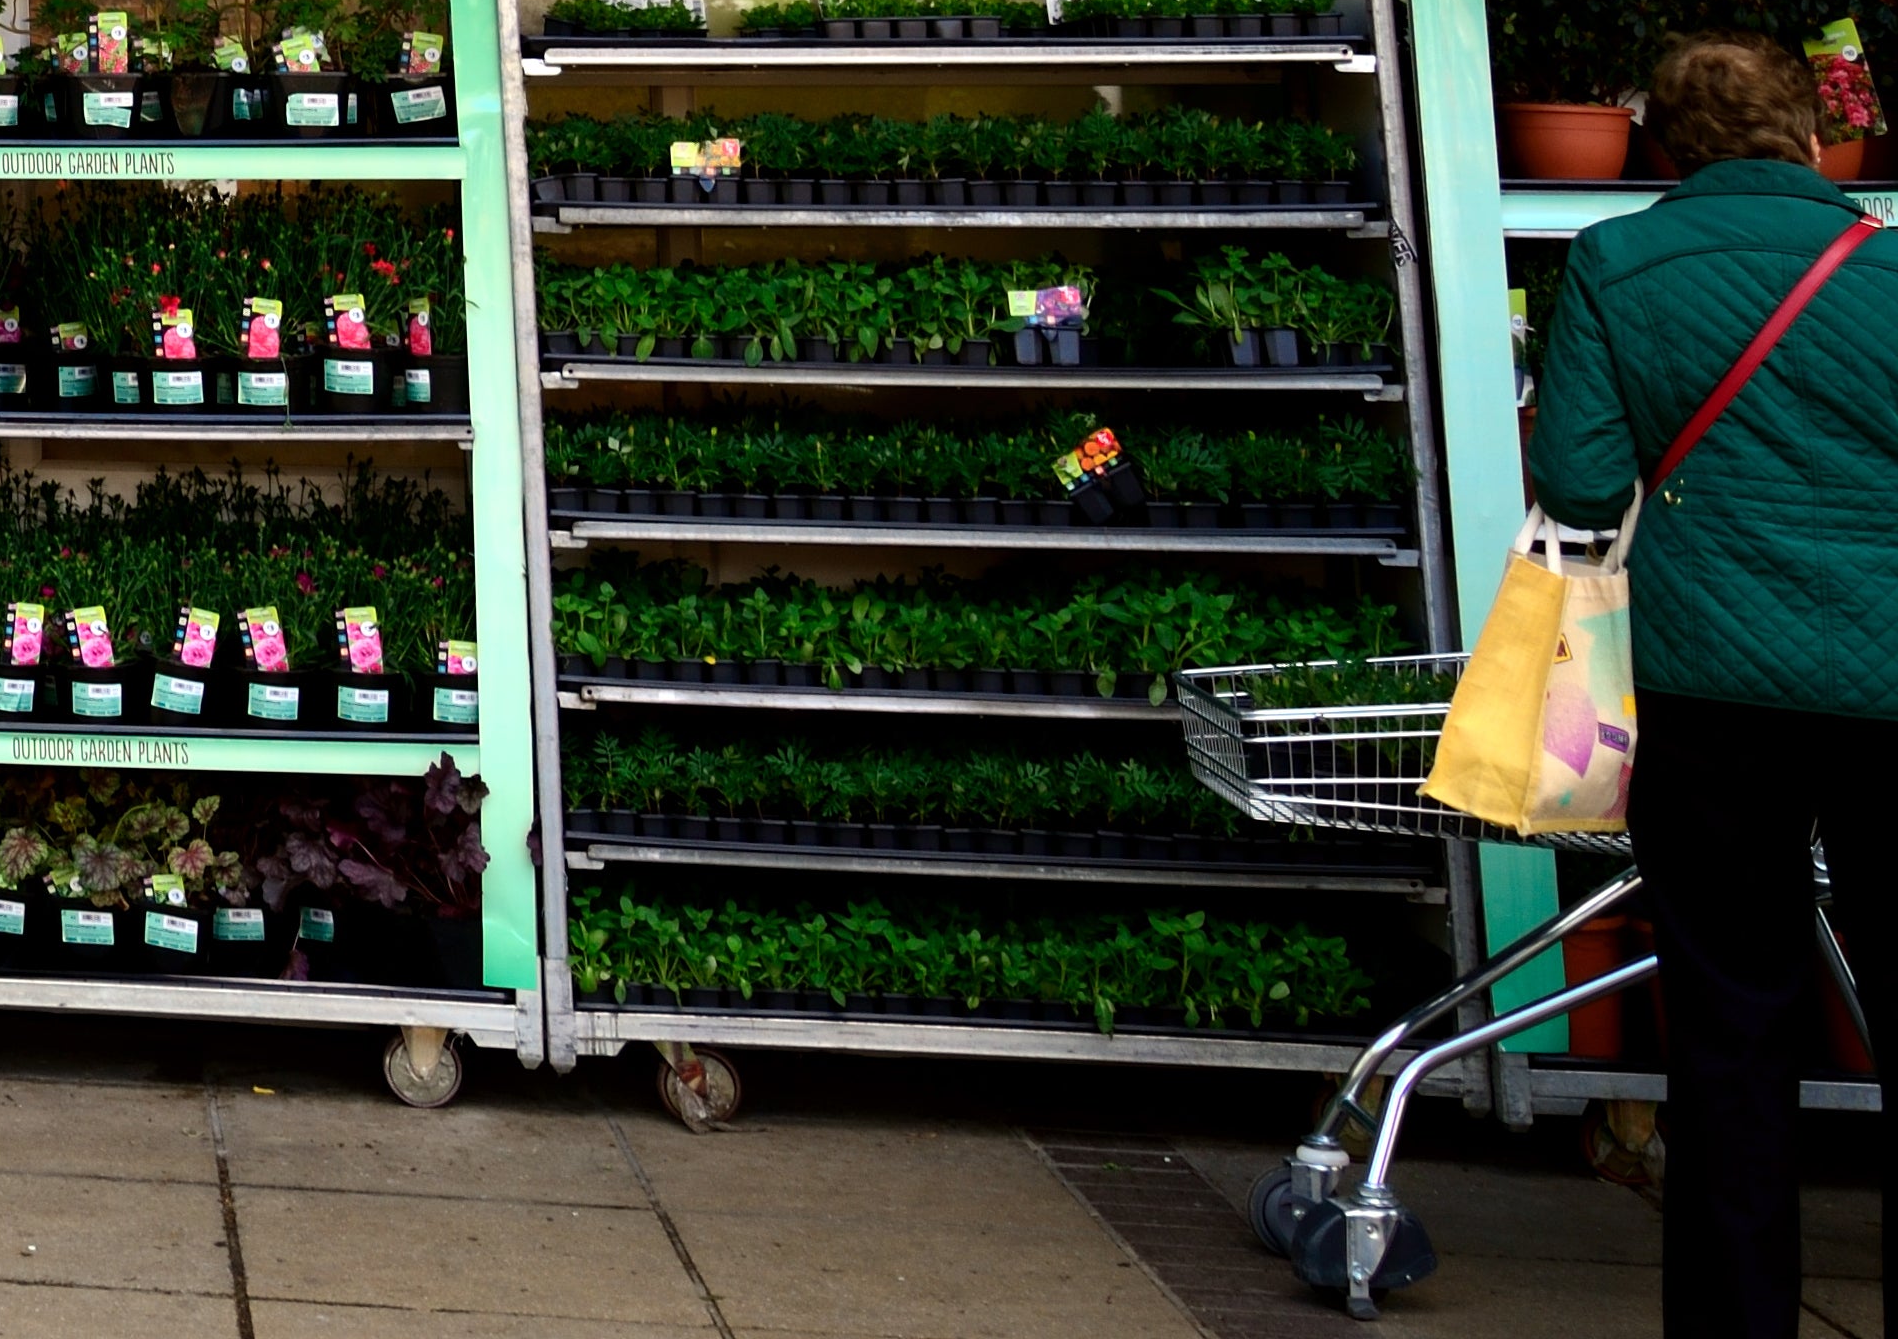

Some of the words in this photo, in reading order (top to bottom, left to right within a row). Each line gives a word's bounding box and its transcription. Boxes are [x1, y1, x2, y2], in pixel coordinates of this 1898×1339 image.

[2, 152, 62, 174] OUTDOOR
[69, 152, 119, 174] GARDEN
[125, 152, 174, 174] PLANTS
[13, 737, 74, 761] OUTDOOR
[81, 739, 131, 763] GARDEN
[139, 741, 189, 765] PLANTS
